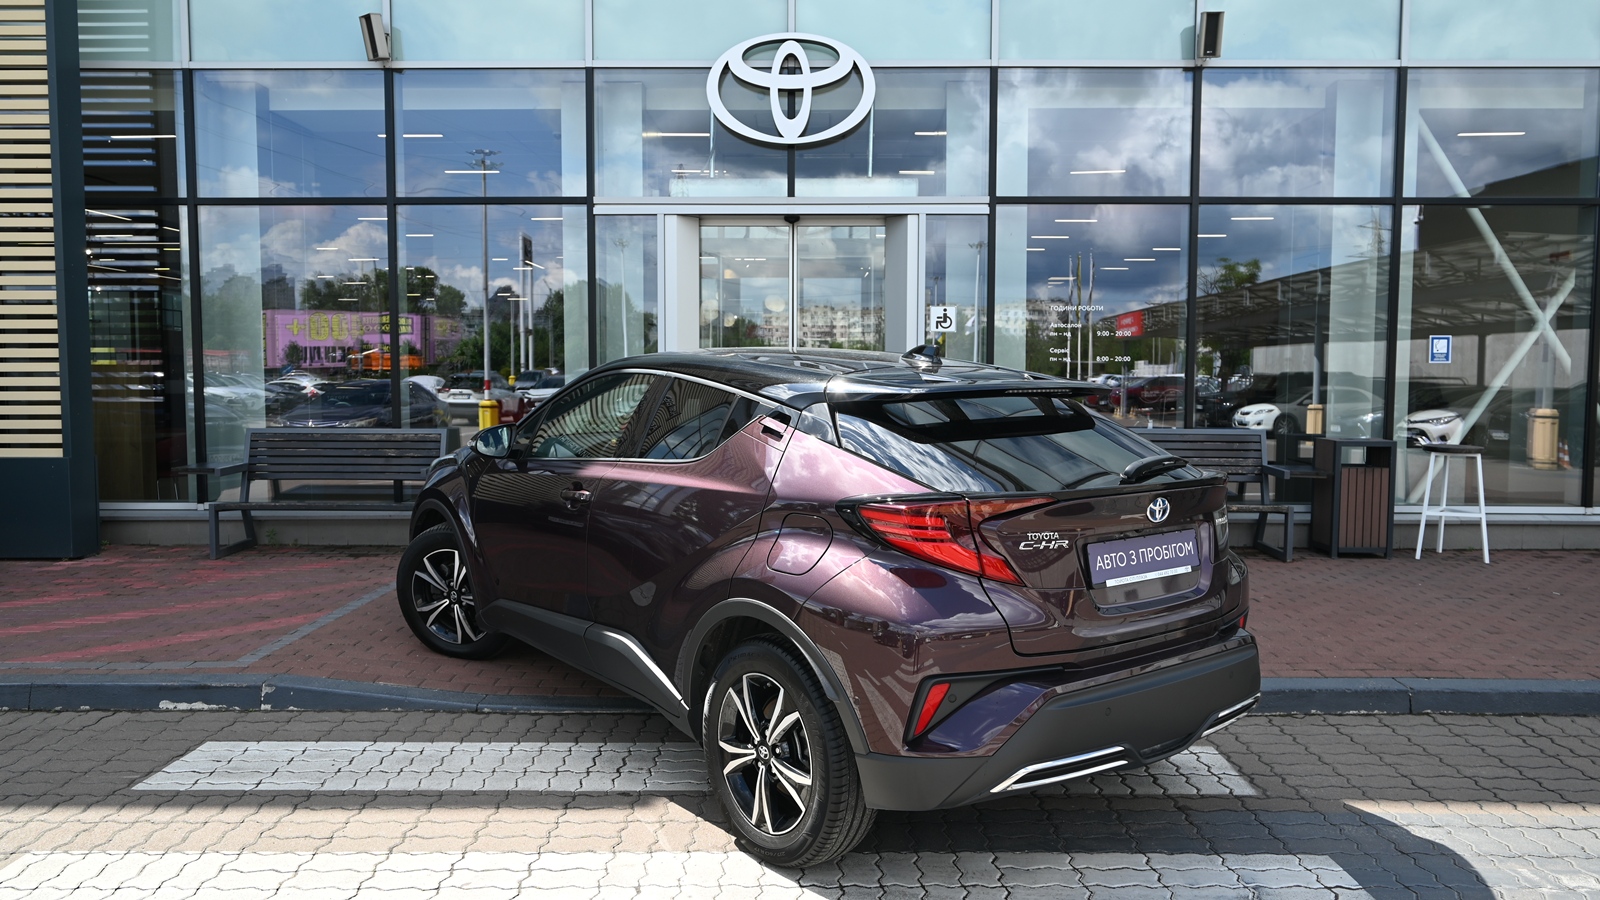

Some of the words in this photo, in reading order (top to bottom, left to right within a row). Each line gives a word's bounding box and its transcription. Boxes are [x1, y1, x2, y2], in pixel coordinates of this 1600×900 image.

[1027, 532, 1059, 540] TOYOTA
[1018, 540, 1069, 550] C-HR
[1096, 552, 1127, 570] АВТО
[1139, 541, 1194, 563] ПРОБІГОМ
